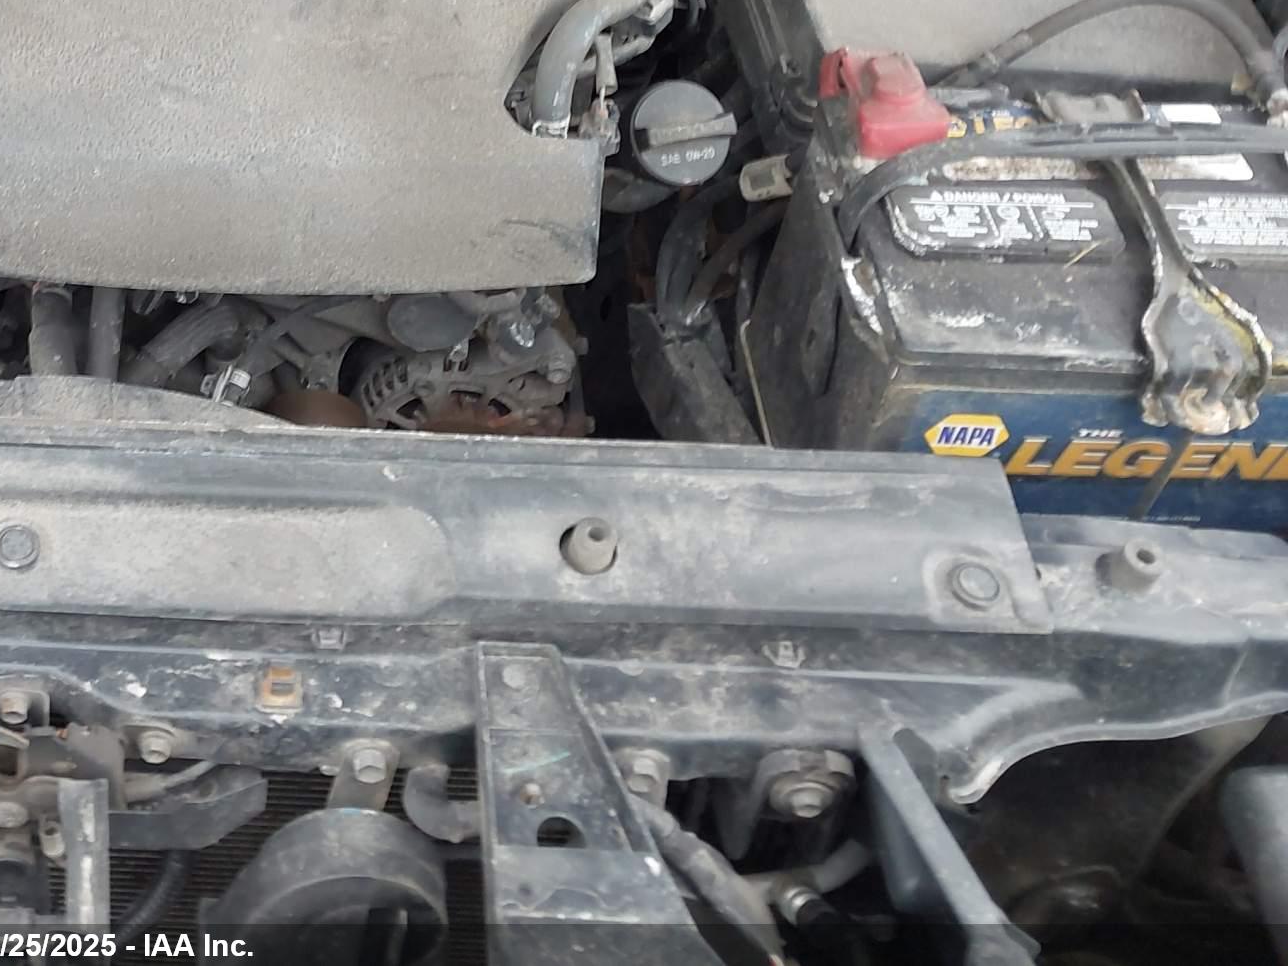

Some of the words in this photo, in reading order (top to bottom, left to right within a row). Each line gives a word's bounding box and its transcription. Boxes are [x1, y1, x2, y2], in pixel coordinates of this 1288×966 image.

[660, 152, 682, 167] SAE
[936, 425, 996, 446] NAPA
[1078, 428, 1123, 438] THE
